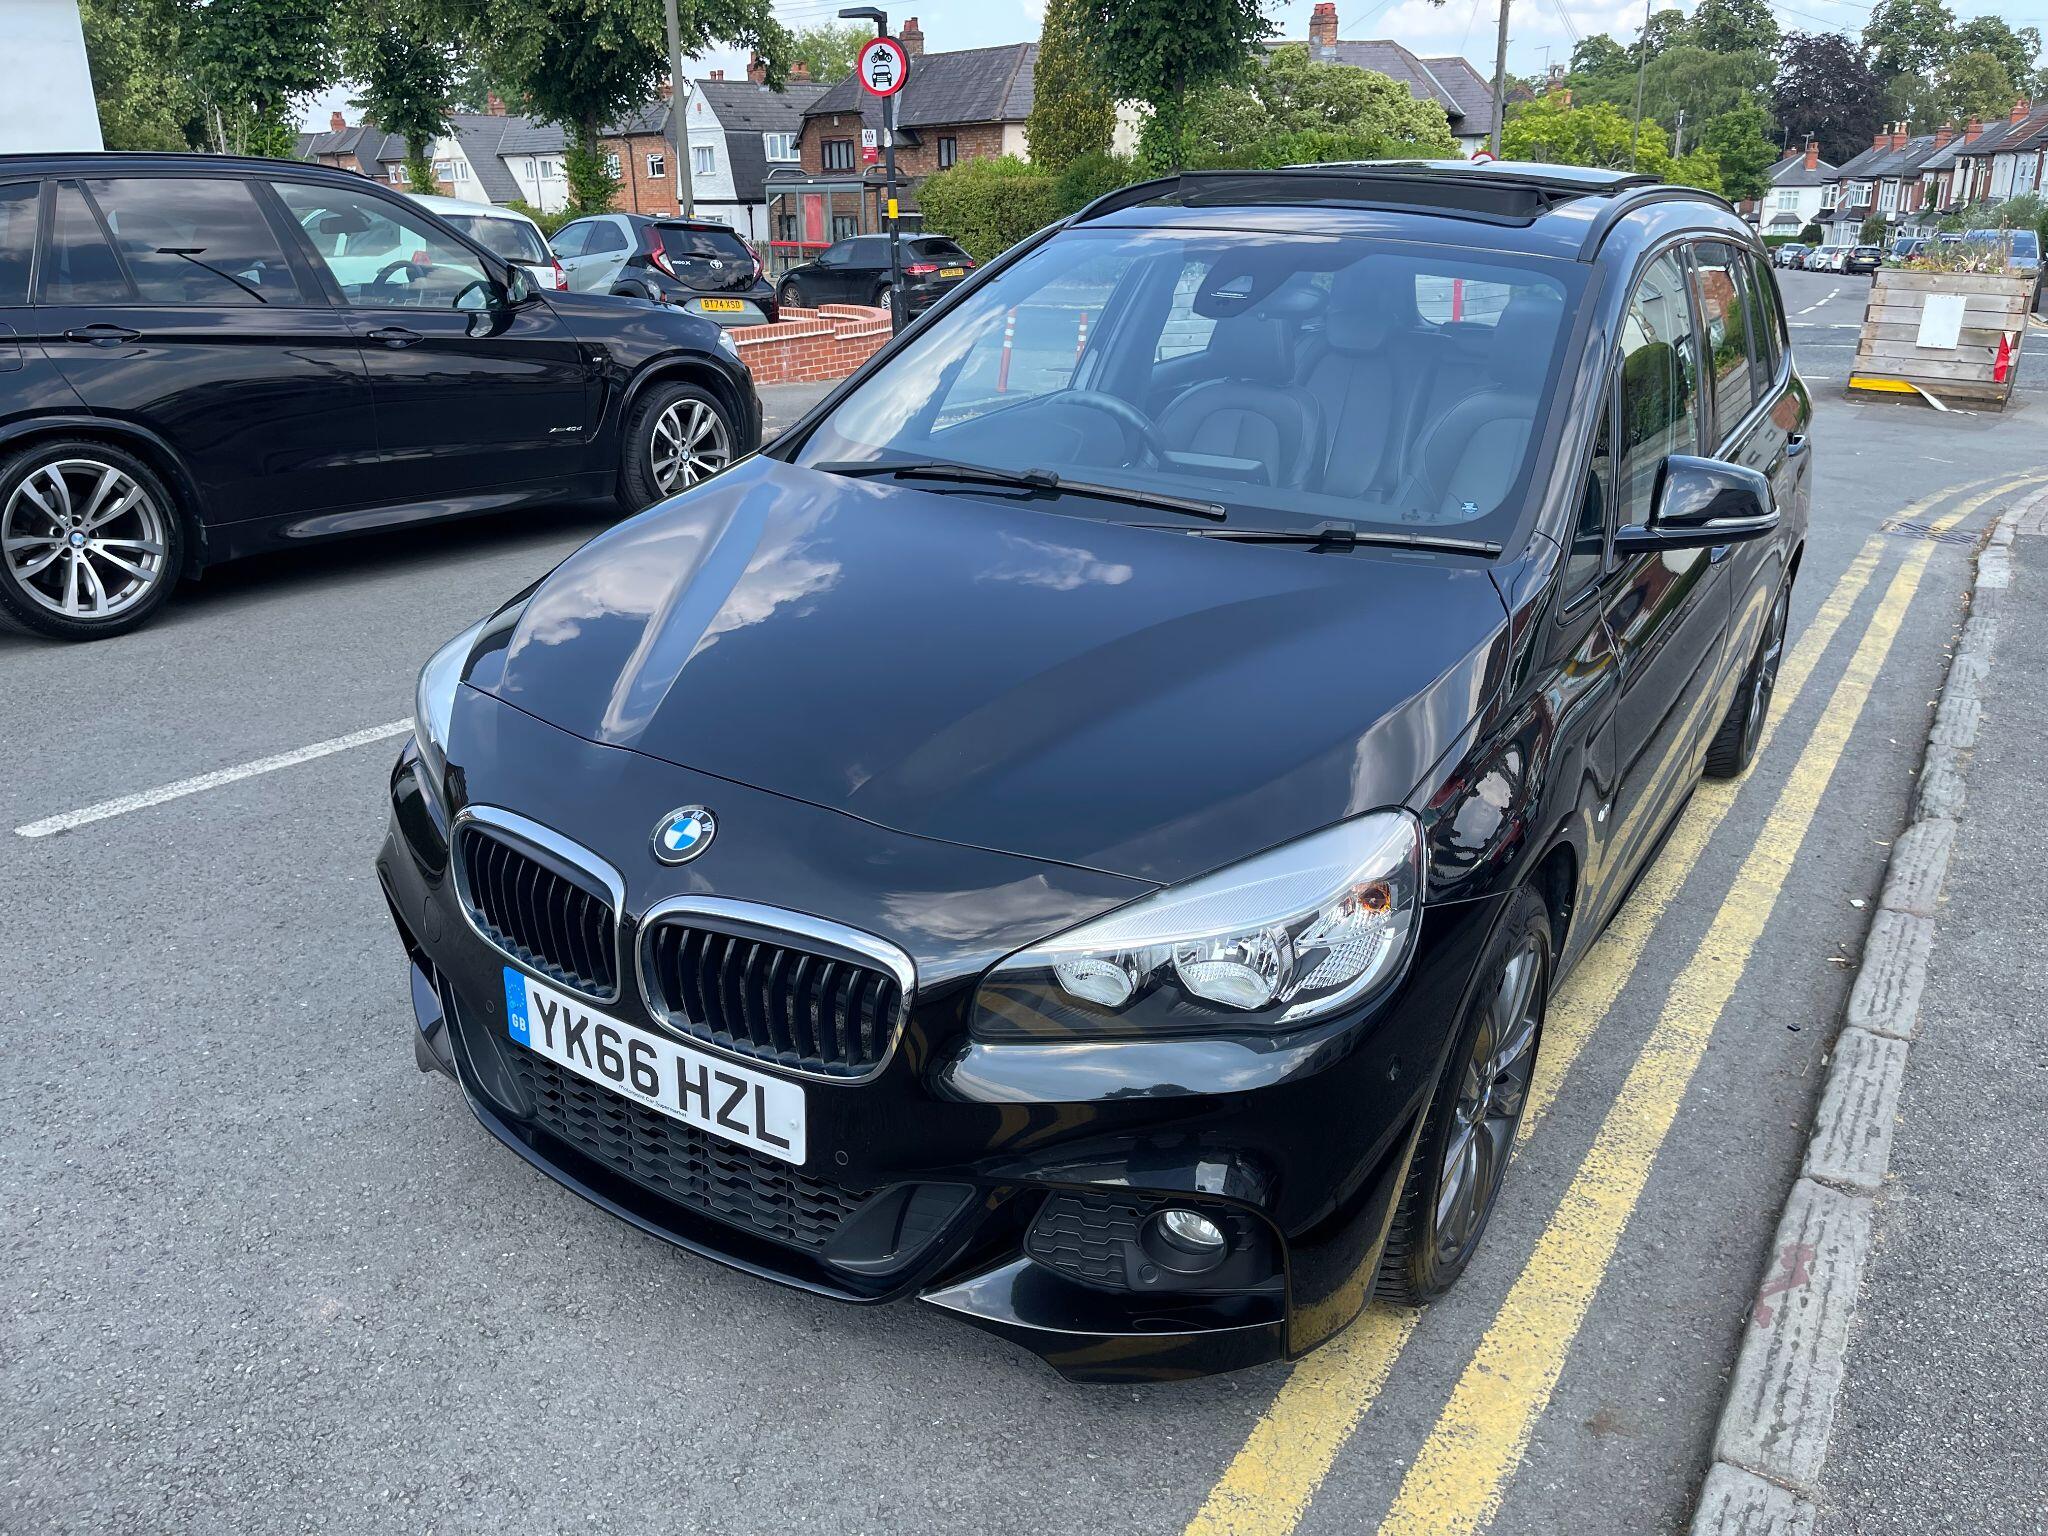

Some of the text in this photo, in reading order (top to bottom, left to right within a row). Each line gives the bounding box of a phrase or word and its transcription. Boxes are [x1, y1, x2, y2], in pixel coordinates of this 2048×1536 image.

[704, 299, 724, 309] BT74
[674, 810, 713, 832] BMW
[512, 1013, 527, 1032] GB
[533, 991, 790, 1150] YK66 HZL
